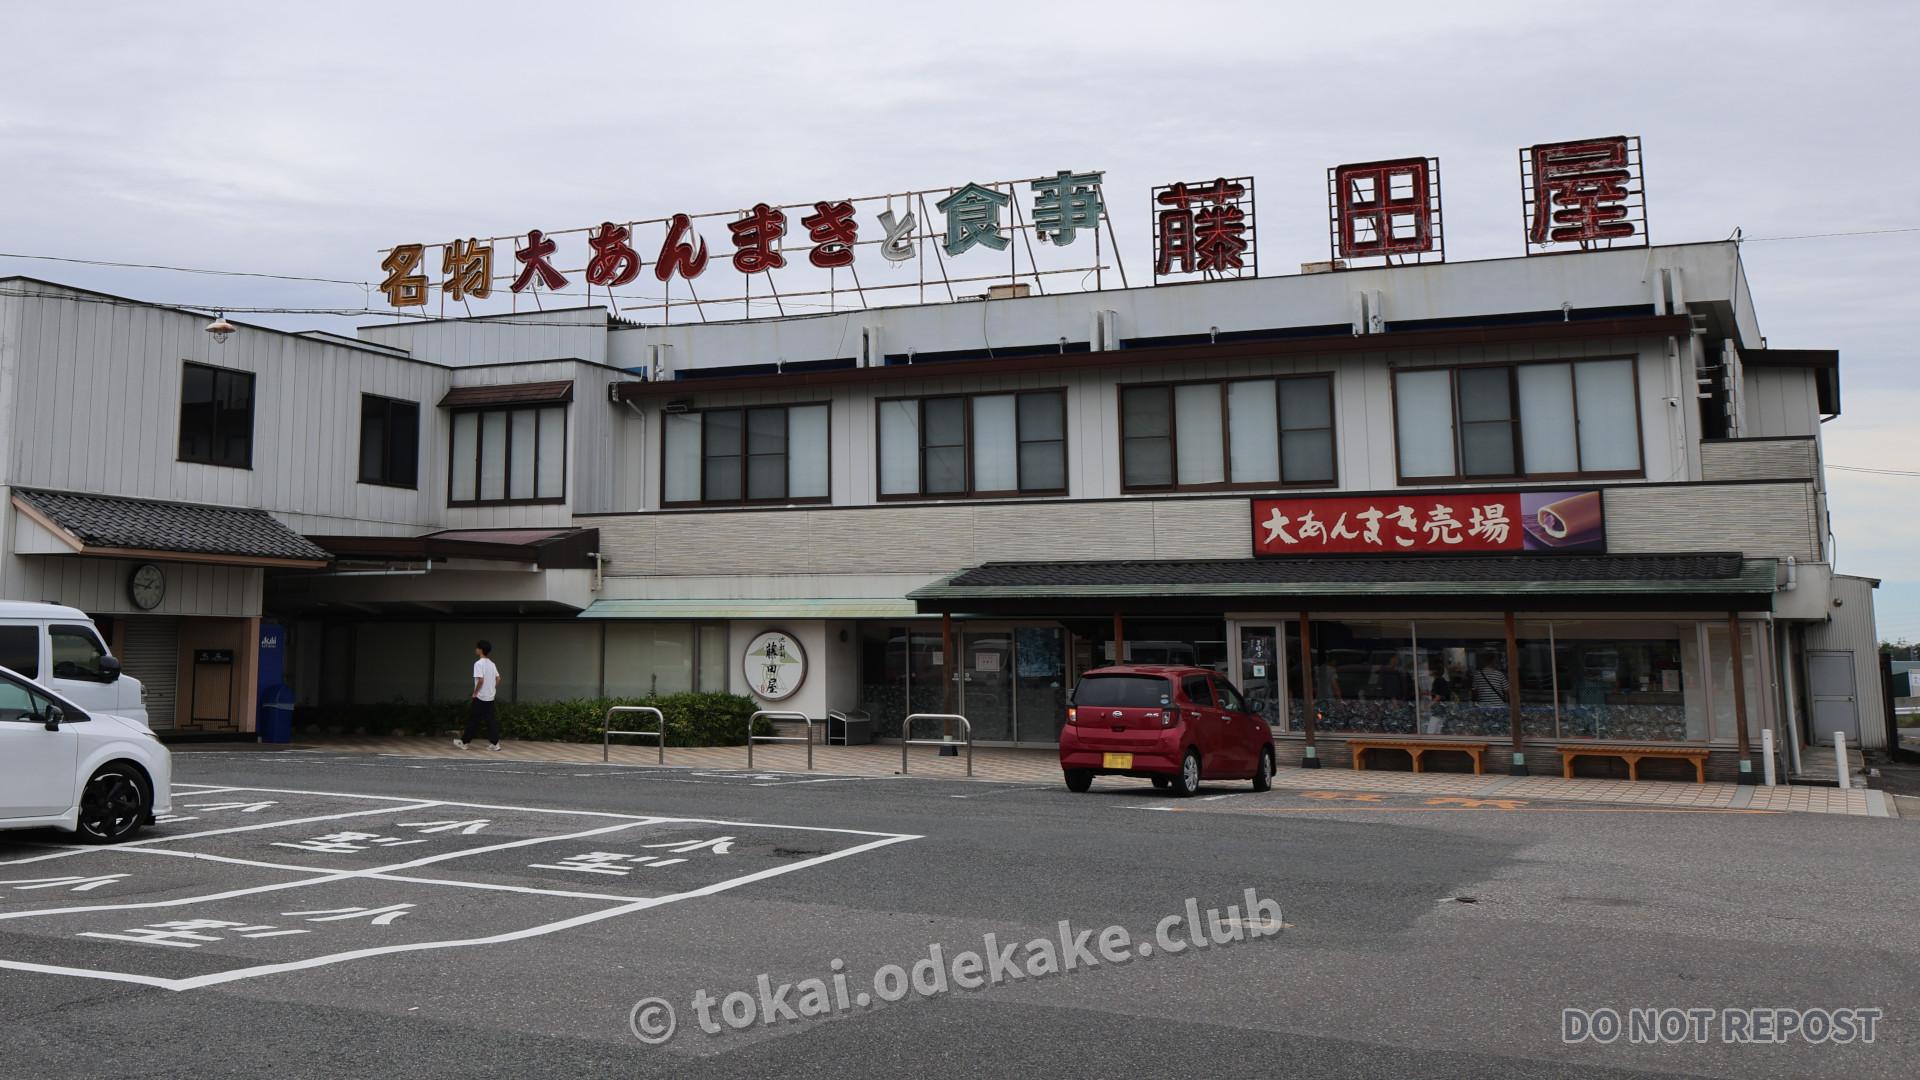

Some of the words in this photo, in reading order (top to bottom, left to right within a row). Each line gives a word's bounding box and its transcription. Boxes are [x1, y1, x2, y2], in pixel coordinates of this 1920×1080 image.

[1262, 503, 1511, 547] 大あんまき売場
[766, 641, 778, 694] 藤田屋
[75, 902, 417, 948] 小型
